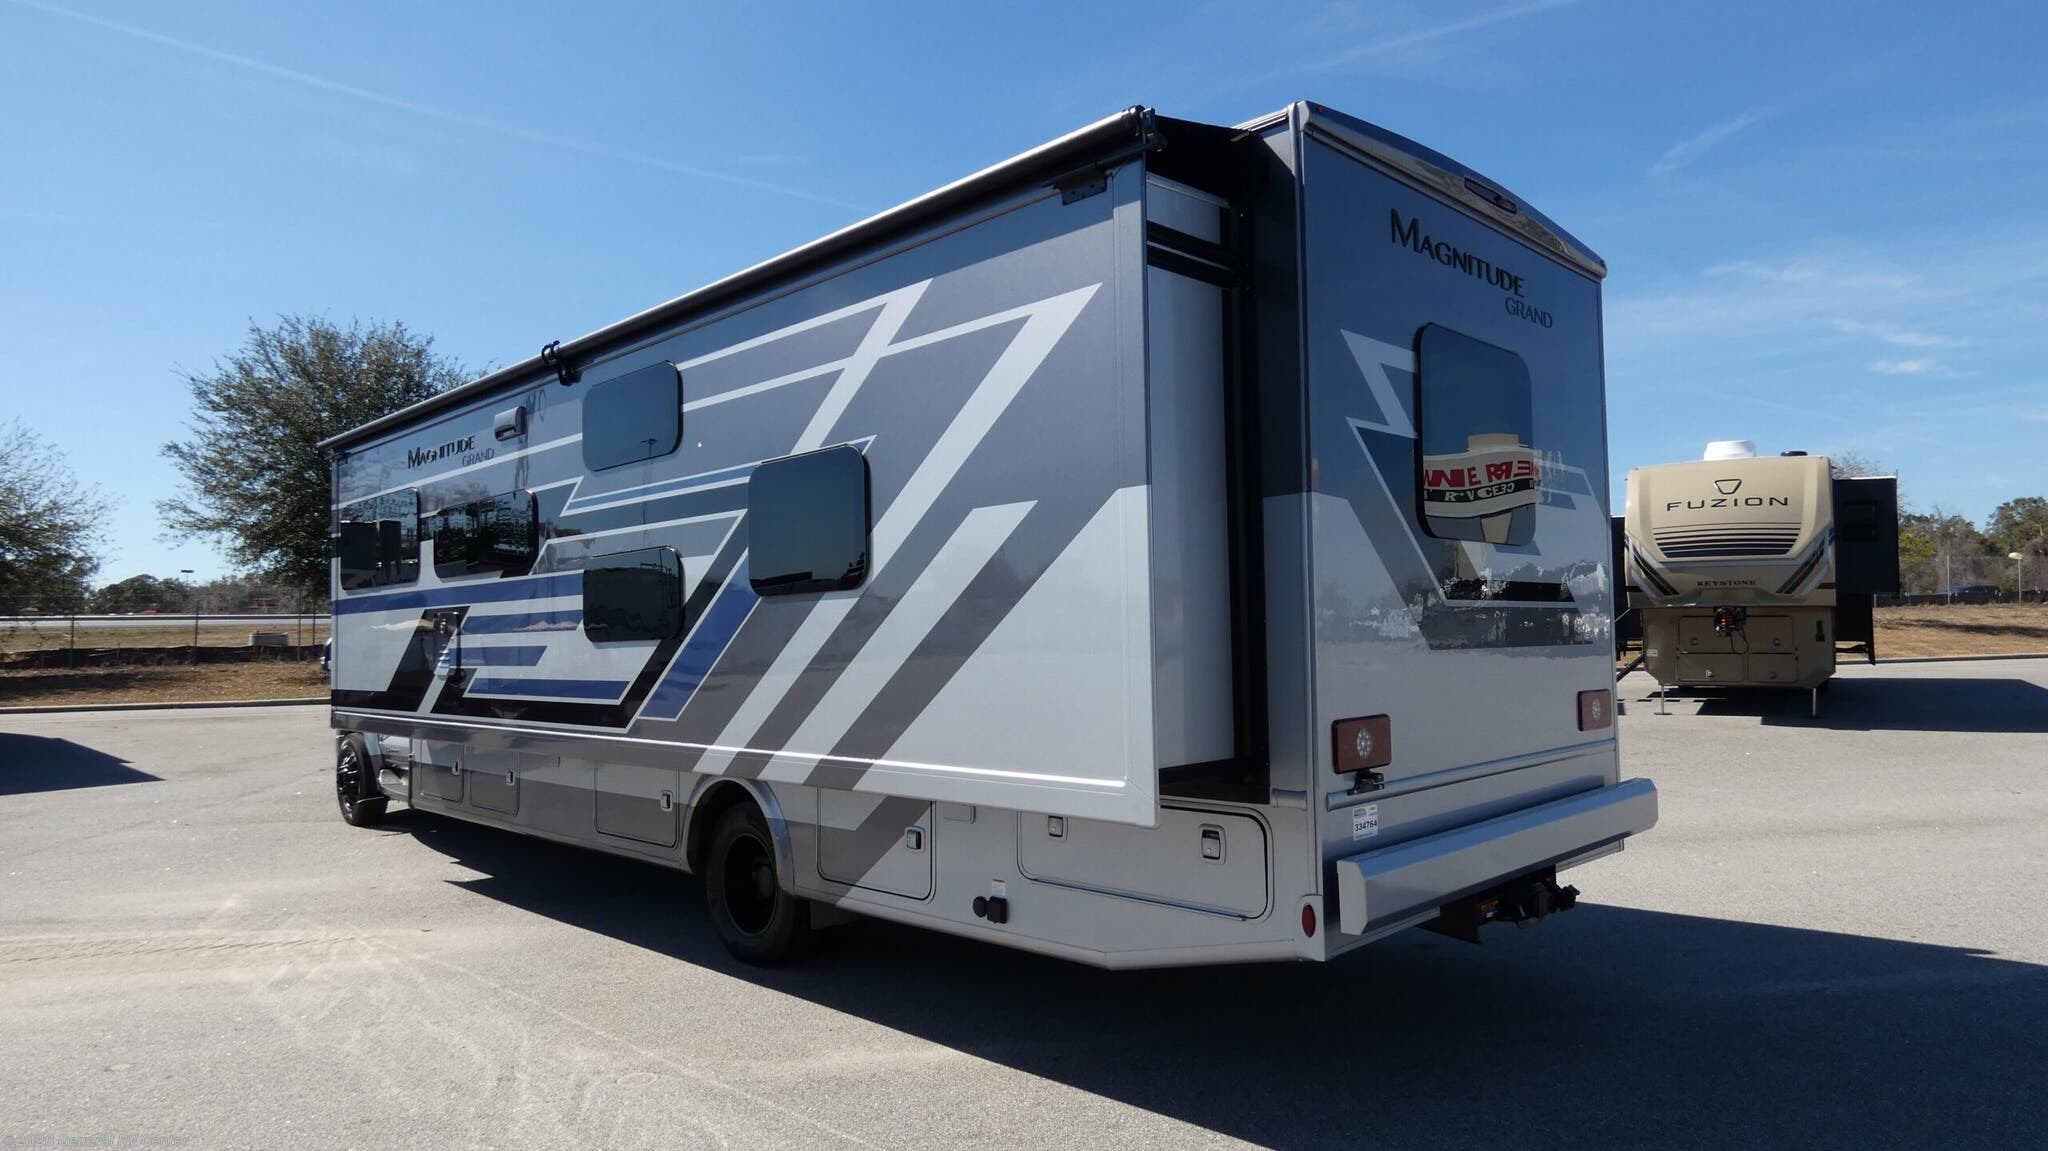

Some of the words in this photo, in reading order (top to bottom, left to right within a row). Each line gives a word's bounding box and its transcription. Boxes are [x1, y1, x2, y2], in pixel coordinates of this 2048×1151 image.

[1390, 207, 1525, 298] MAGNITUDE
[1505, 297, 1553, 329] GRAND
[407, 435, 476, 469] MAGNITUDE
[462, 448, 495, 467] GRAND
[1666, 496, 1788, 512] FUZION
[1354, 819, 1378, 831] 334764
